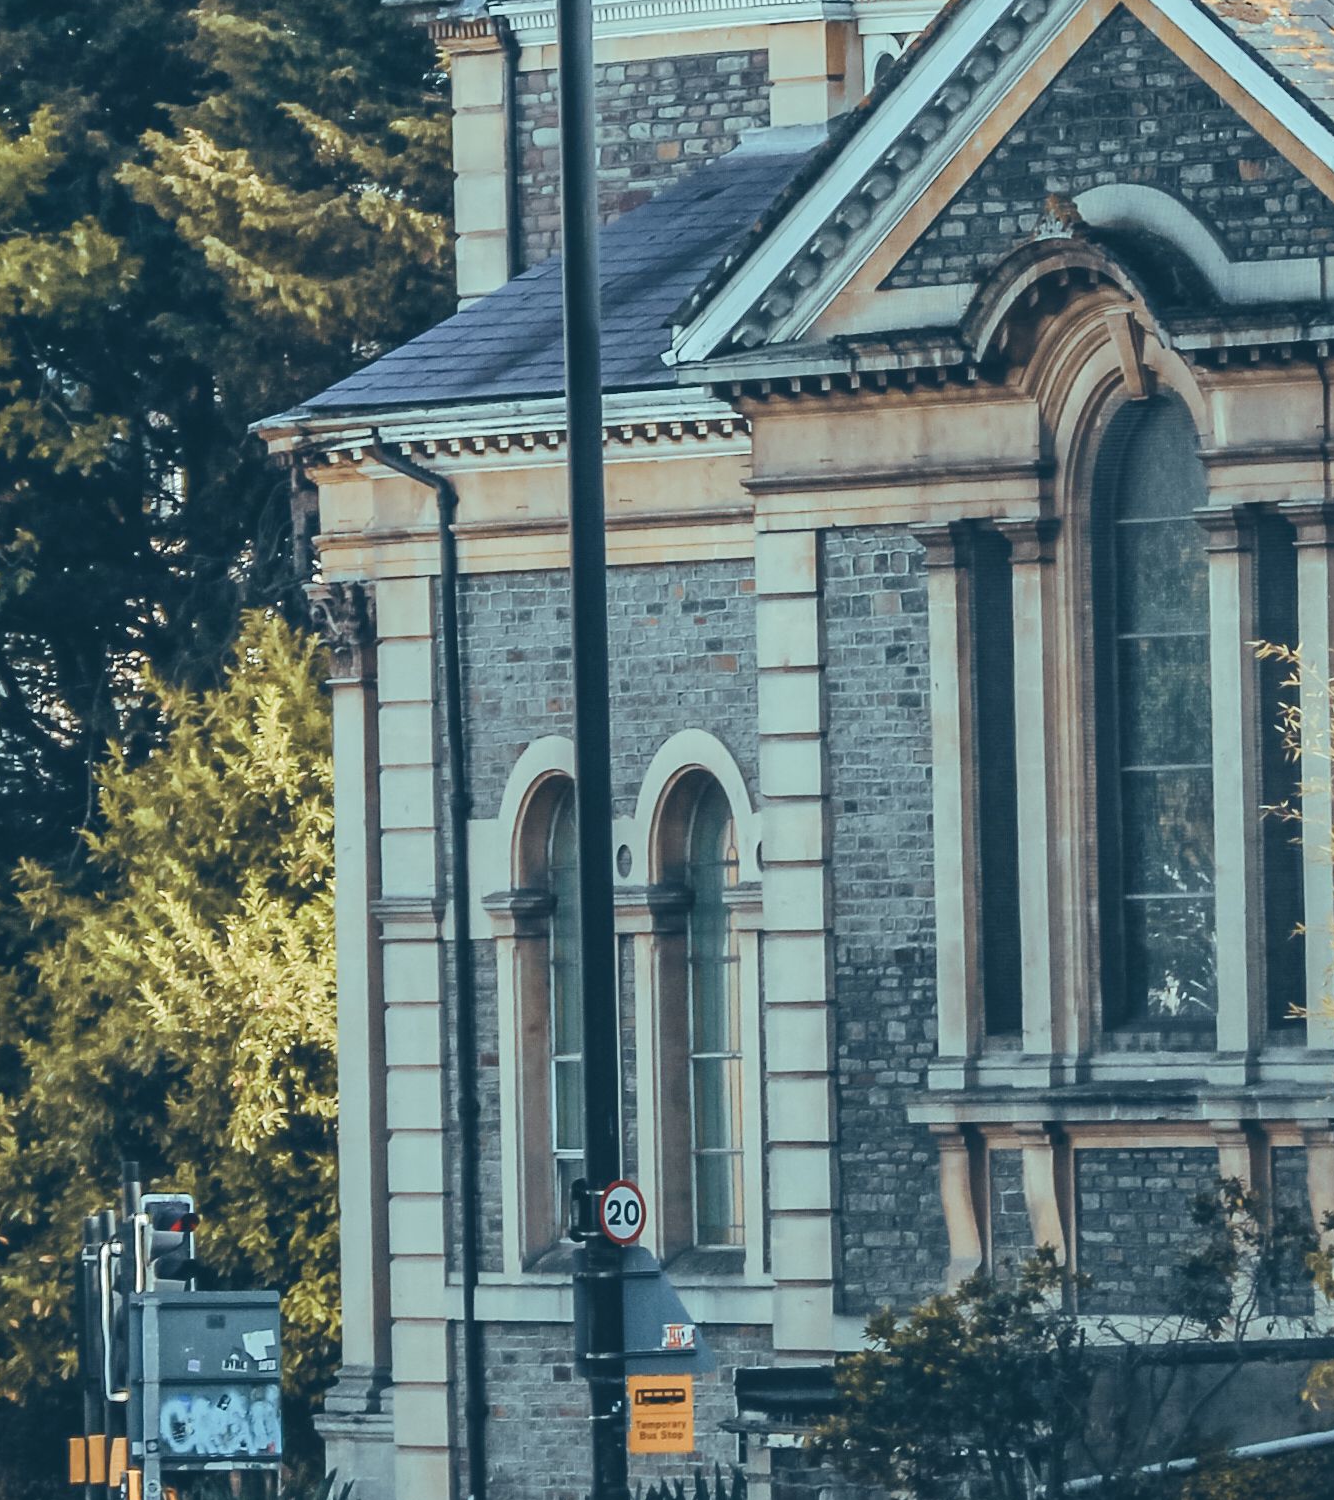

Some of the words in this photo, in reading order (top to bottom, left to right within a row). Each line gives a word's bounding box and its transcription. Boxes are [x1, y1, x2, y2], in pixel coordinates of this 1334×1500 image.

[607, 1199, 640, 1226] 20
[636, 1420, 686, 1430] Temporary
[639, 1431, 657, 1440] Bus
[660, 1430, 683, 1441] Stop
